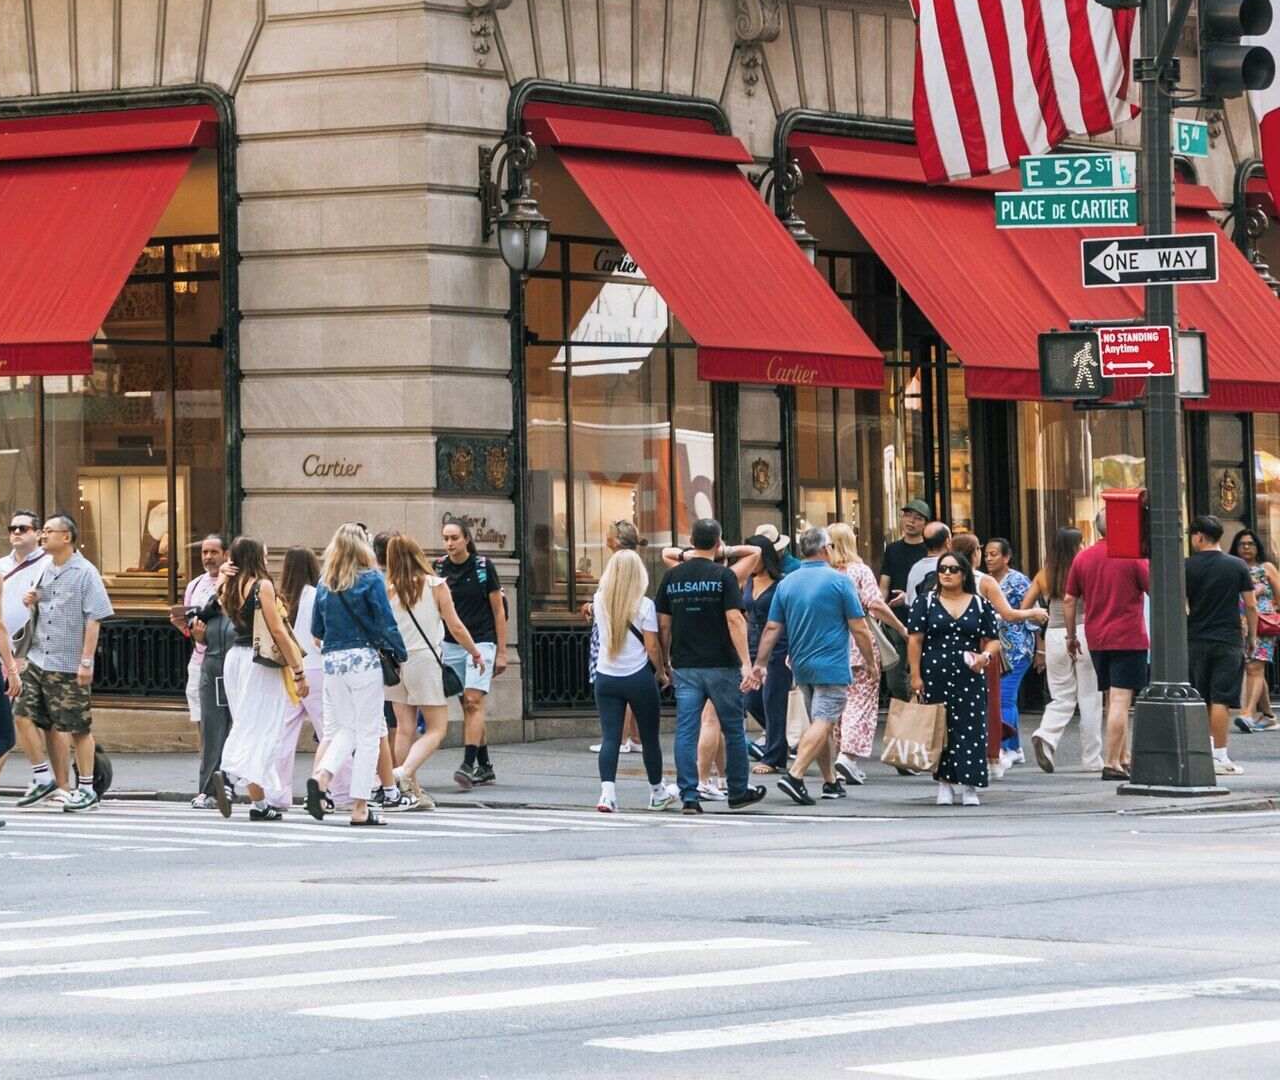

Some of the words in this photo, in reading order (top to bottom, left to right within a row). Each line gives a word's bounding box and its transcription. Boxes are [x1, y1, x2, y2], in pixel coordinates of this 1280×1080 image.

[1181, 125, 1190, 151] 5
[1025, 161, 1043, 186] E
[1054, 158, 1092, 186] 52
[1095, 158, 1112, 172] ST
[1001, 200, 1045, 220] PLACE
[1052, 204, 1066, 219] DE
[1071, 199, 1129, 219] CARTIER
[1103, 253, 1139, 270] ONE
[1157, 250, 1197, 268] WAY
[1103, 333, 1116, 343] NO
[1117, 332, 1159, 342] STANDING
[1104, 344, 1139, 355] Anytime
[767, 355, 818, 383] Cartier
[302, 454, 362, 477] Cartier
[474, 528, 507, 549] Building
[666, 581, 723, 595] ALLSAINTS
